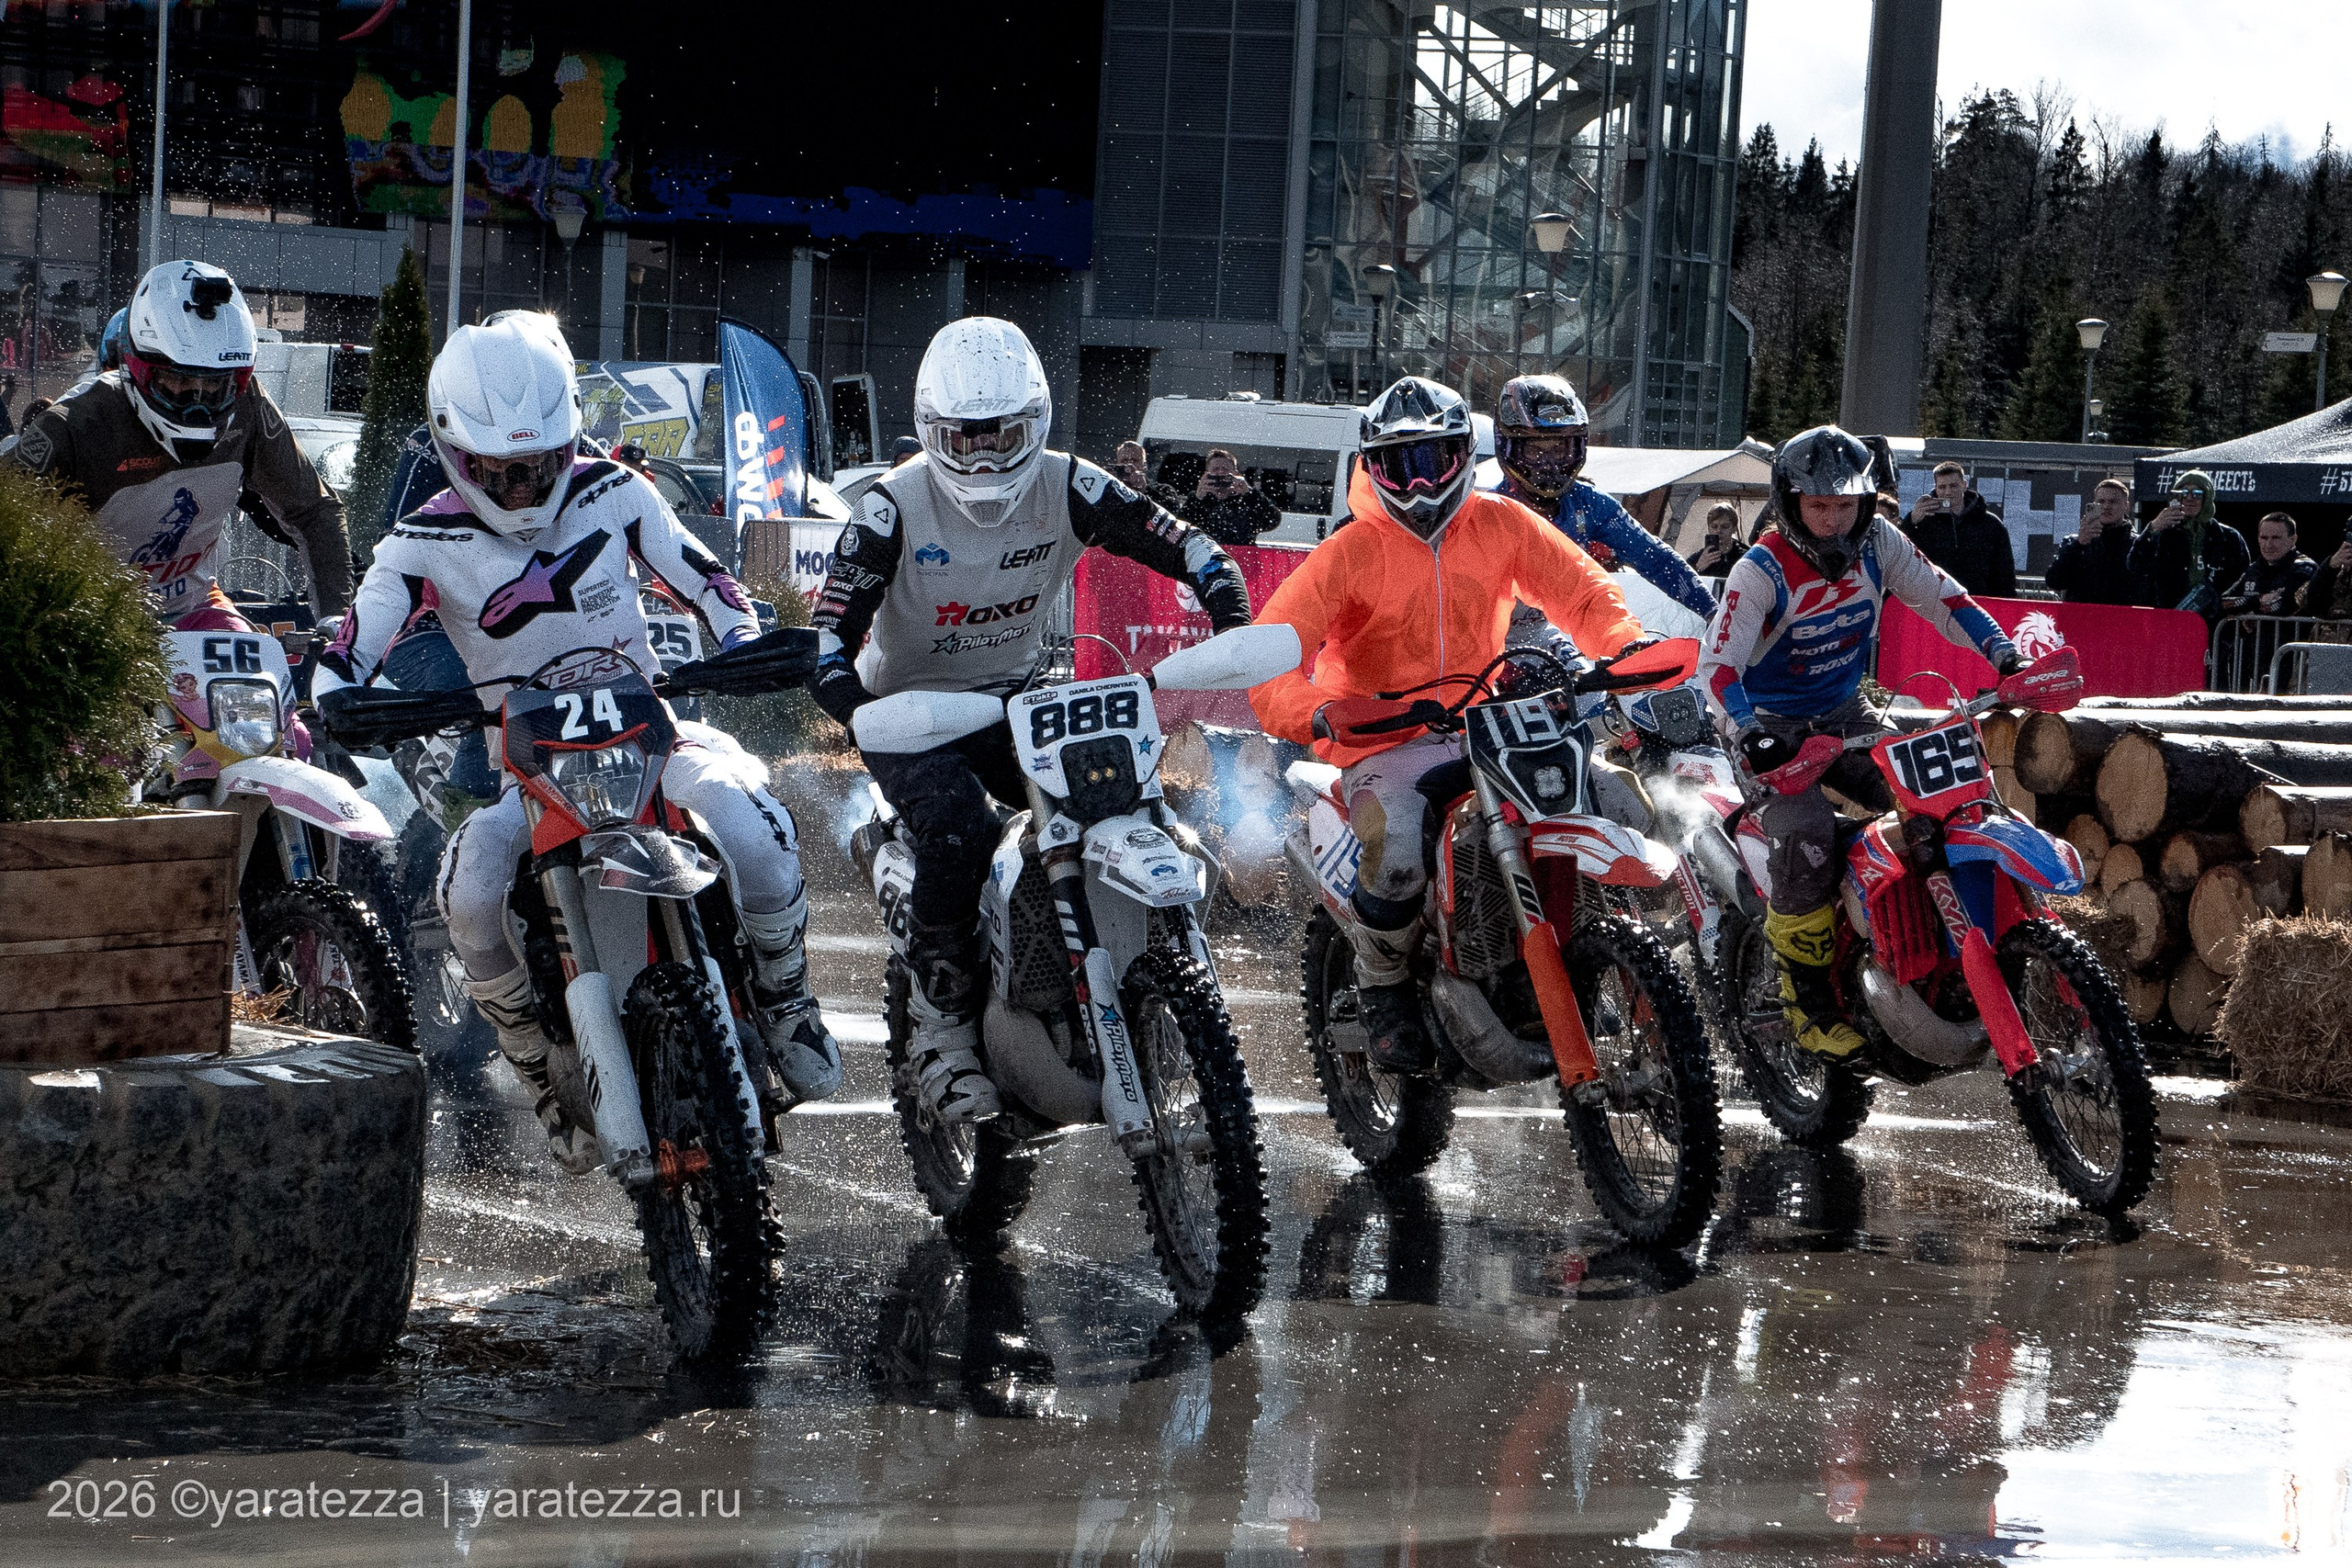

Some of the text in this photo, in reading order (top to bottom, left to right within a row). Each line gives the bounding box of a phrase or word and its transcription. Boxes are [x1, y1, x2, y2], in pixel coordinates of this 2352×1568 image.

[512, 430, 536, 440] BELL
[1000, 540, 1057, 570] LEATT
[934, 593, 1039, 626] ROXO
[1792, 609, 1871, 639] Beta
[203, 637, 260, 672] 56
[1791, 641, 1841, 656] MOTO
[1069, 686, 1095, 696] DANILA
[554, 688, 624, 740] 24
[1030, 691, 1139, 750] 888
[1481, 697, 1562, 750] 119
[1892, 723, 1985, 797] 165
